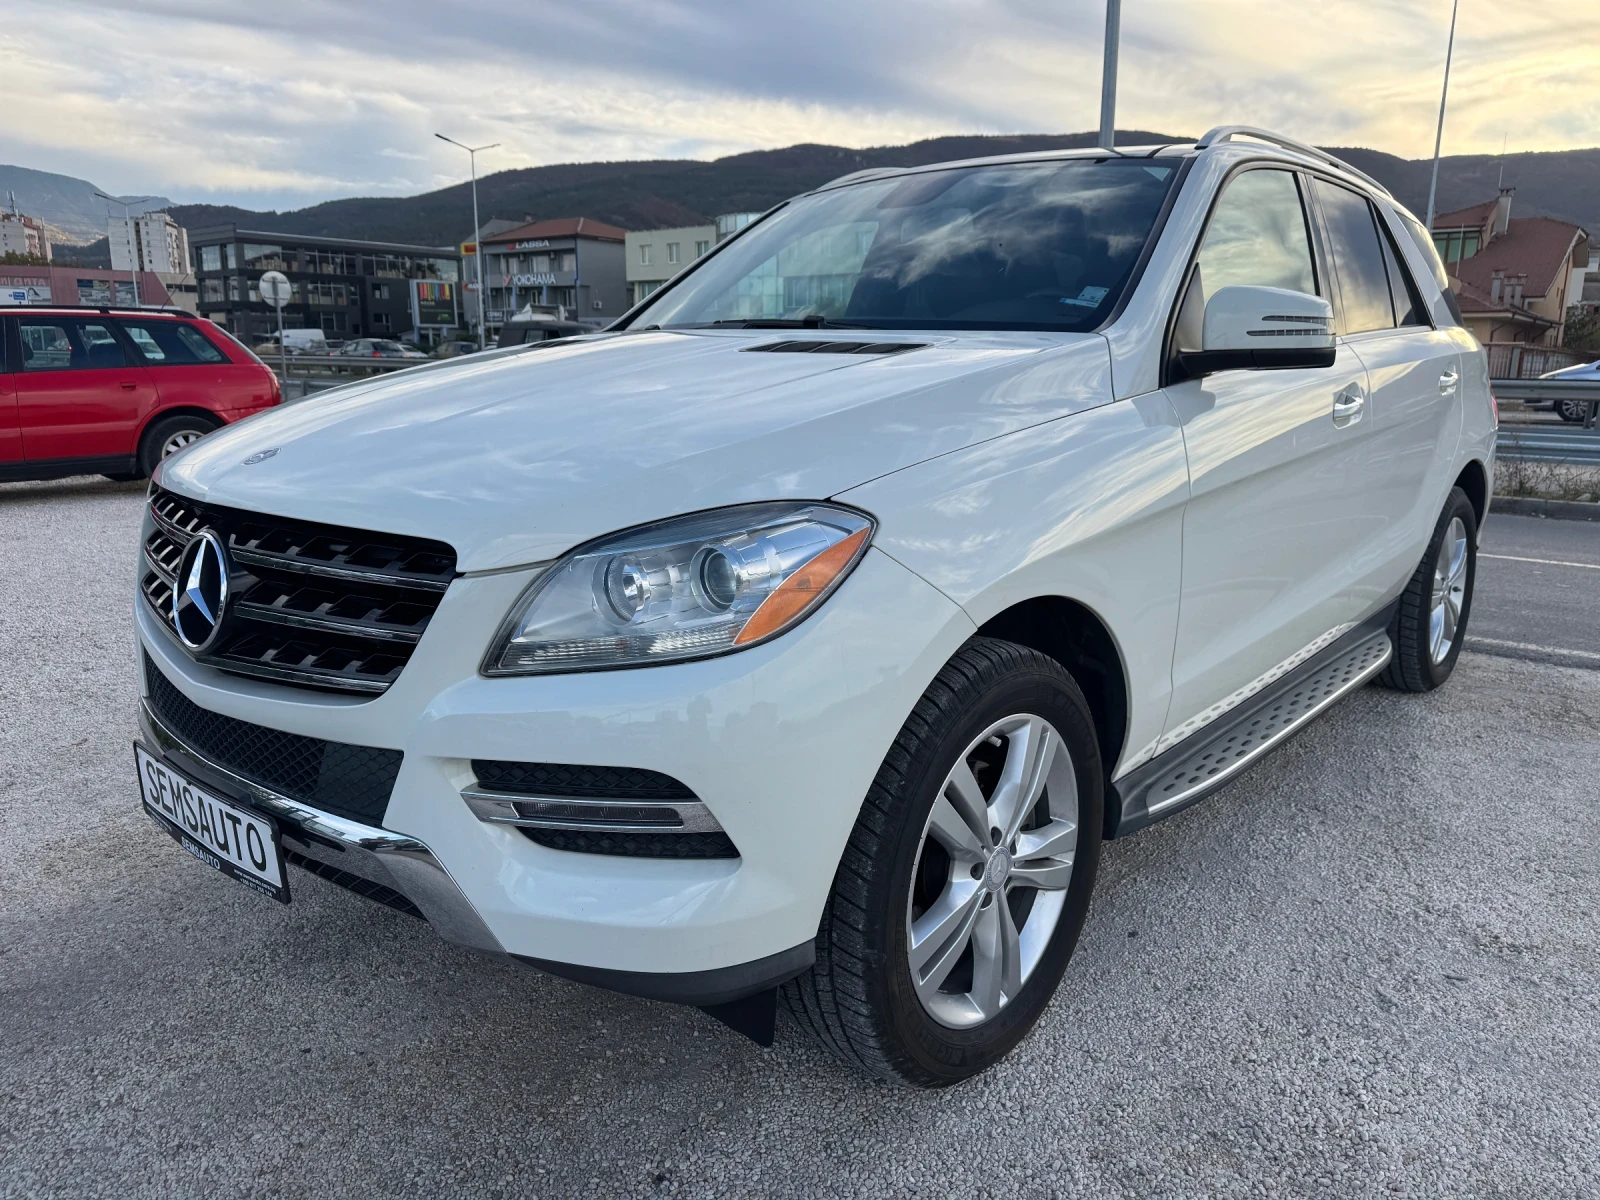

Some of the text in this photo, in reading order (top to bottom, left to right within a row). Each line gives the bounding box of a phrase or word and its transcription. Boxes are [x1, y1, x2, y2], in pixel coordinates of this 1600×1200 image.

[515, 239, 550, 249] LASSA
[512, 273, 556, 285] YOKOHAMA
[145, 760, 267, 872] SEMSAUTO
[181, 836, 220, 869] SEMSAUTO
